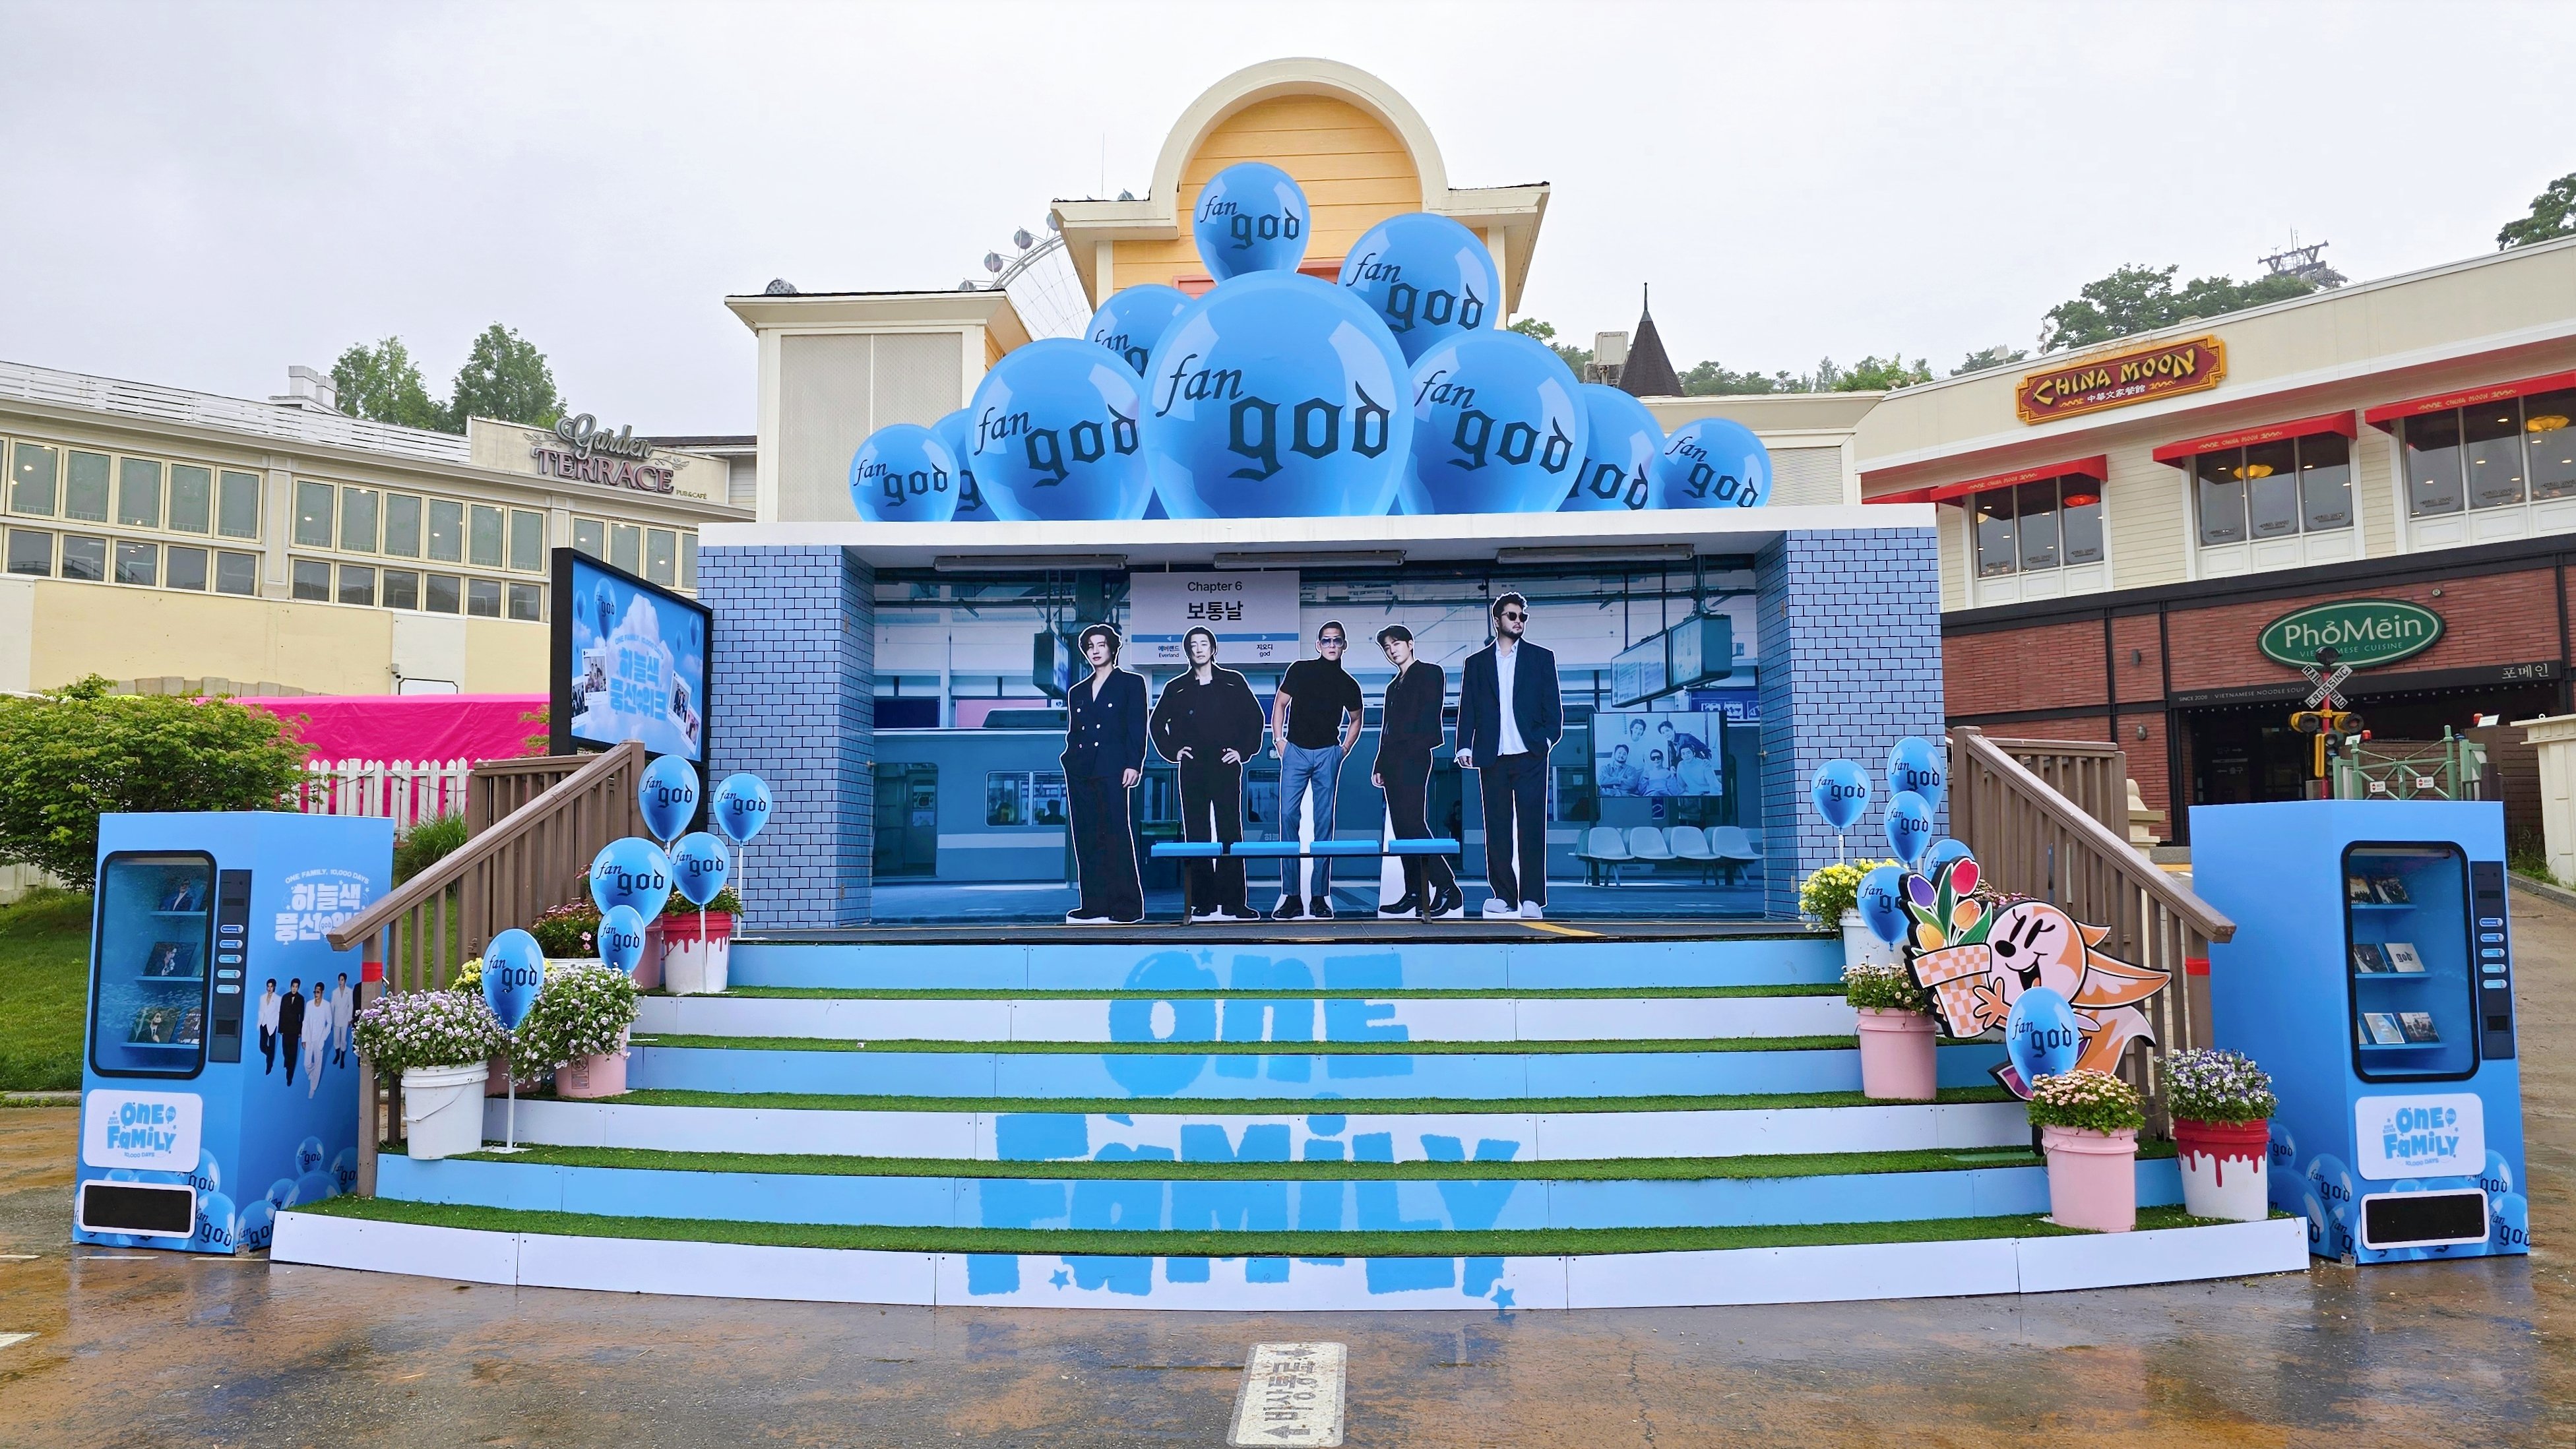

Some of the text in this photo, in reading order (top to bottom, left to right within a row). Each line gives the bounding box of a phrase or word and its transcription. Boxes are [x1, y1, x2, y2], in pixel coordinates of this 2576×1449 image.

[1200, 196, 1300, 250] fan god
[1346, 253, 1484, 334] fan god
[2032, 348, 2195, 405] CHINA MOON
[2445, 392, 2488, 406] CHINA MOON
[1156, 354, 1390, 482] fan god
[1414, 370, 1573, 474] fan god
[555, 413, 654, 460] Garden
[974, 404, 1139, 488] fan god
[531, 448, 674, 494] TERRACE
[854, 459, 889, 486] fan
[883, 462, 948, 507] god
[1664, 436, 1759, 508] fan god
[1187, 581, 1242, 594] Chapter 6
[601, 601, 615, 617] god
[1187, 601, 1243, 621] 보통날
[2300, 642, 2403, 658] VIEMESE CUISINE
[619, 647, 660, 687] 하늘색
[2303, 665, 2321, 685] RAIL
[2501, 663, 2549, 679] 포메인
[2307, 667, 2348, 706] CROSSING
[1891, 757, 1910, 775] fan
[642, 776, 693, 809] fan god
[717, 789, 767, 816] fan god
[1814, 774, 1866, 802] fan god
[1887, 807, 1929, 836] fan god
[285, 873, 300, 884] ONE
[352, 872, 370, 884] DAYS
[674, 851, 724, 878] fan god
[1928, 857, 1939, 871] fa
[596, 861, 665, 897] fan god
[291, 883, 361, 911] 하늘색
[1861, 884, 1901, 914] fan go
[600, 923, 640, 952] fan god
[487, 954, 538, 994] fan god
[2013, 1018, 2072, 1059] fan god
[304, 1152, 321, 1165] god
[2272, 1142, 2293, 1159] god
[340, 1169, 358, 1185] go
[2309, 1169, 2350, 1202] fan god
[200, 1222, 233, 1247] god
[237, 1219, 274, 1250] fan go
[2329, 1218, 2348, 1234] fan
[2499, 1225, 2530, 1247] god
